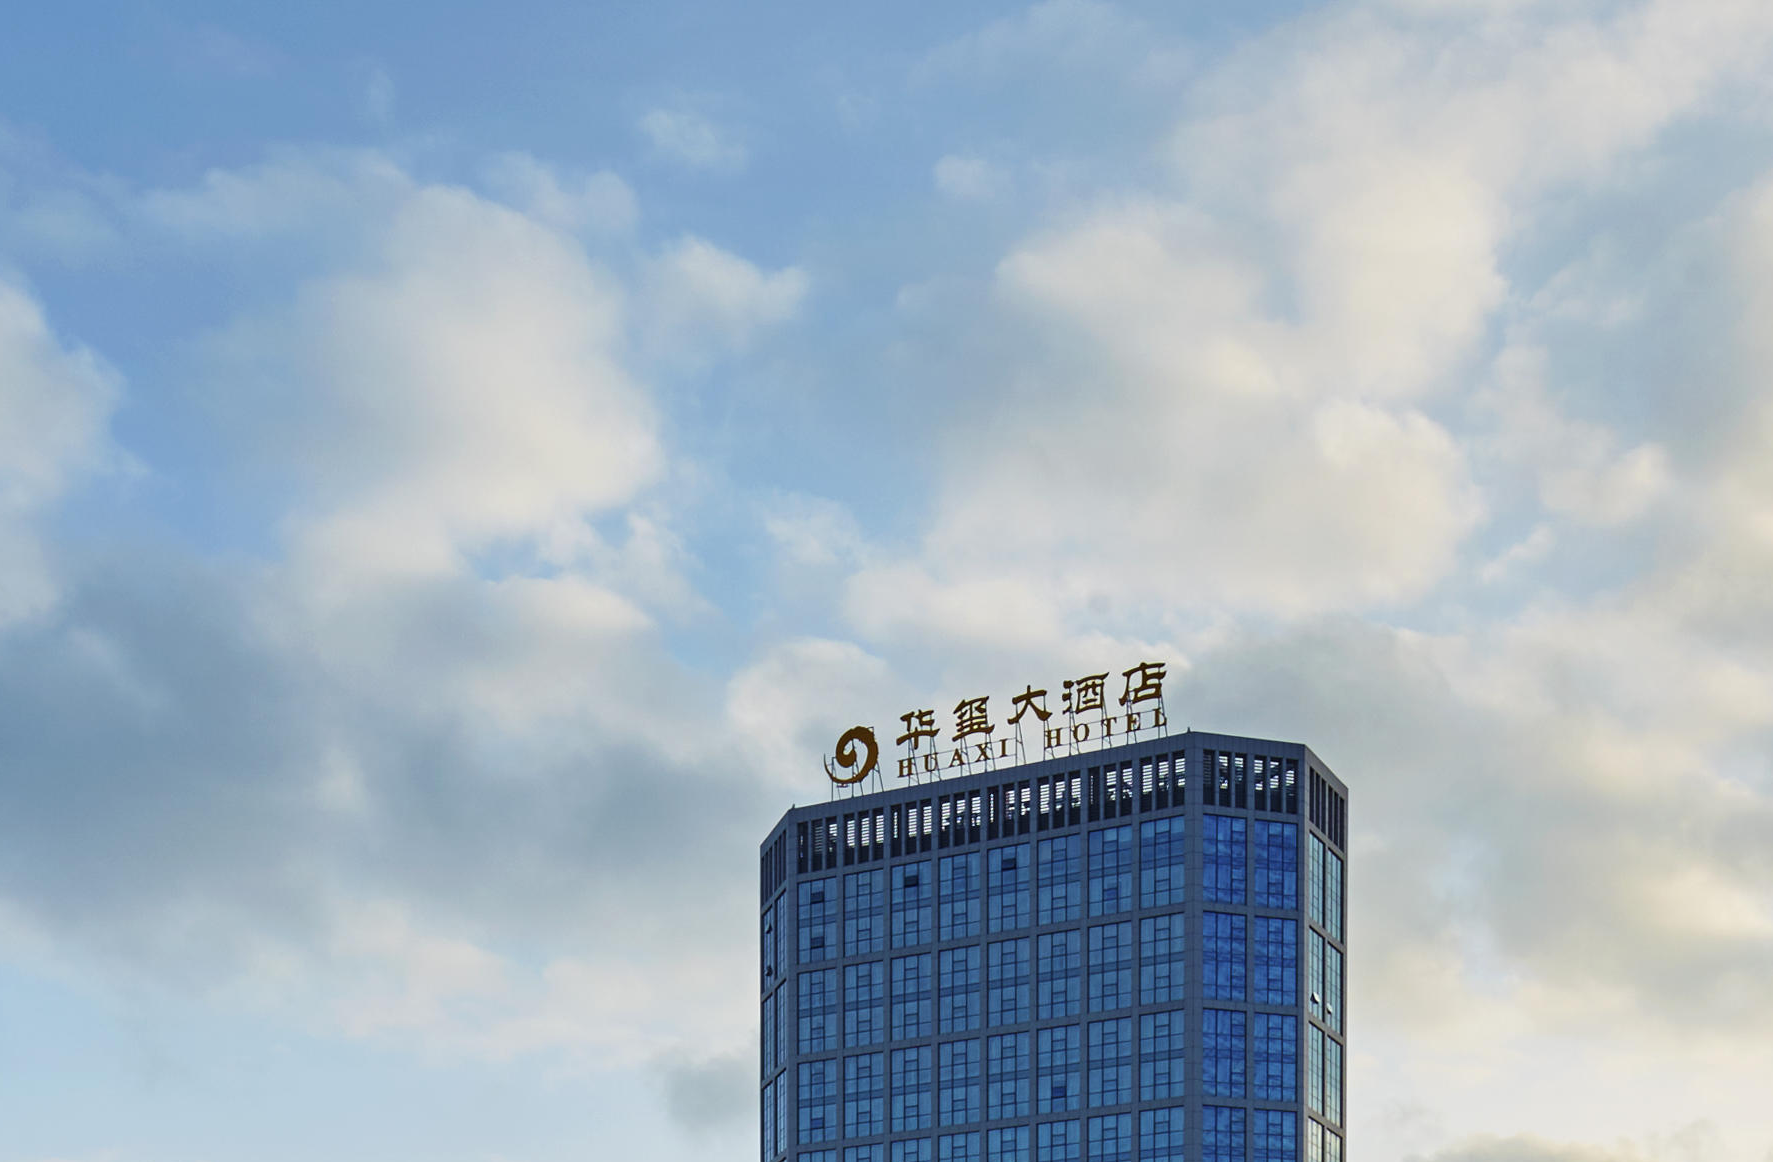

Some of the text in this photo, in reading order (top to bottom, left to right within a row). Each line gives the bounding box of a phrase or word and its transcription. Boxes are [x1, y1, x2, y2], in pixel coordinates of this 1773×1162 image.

[896, 662, 1167, 749] 华玺大酒店
[897, 707, 1168, 778] HUAXI HOTEL
